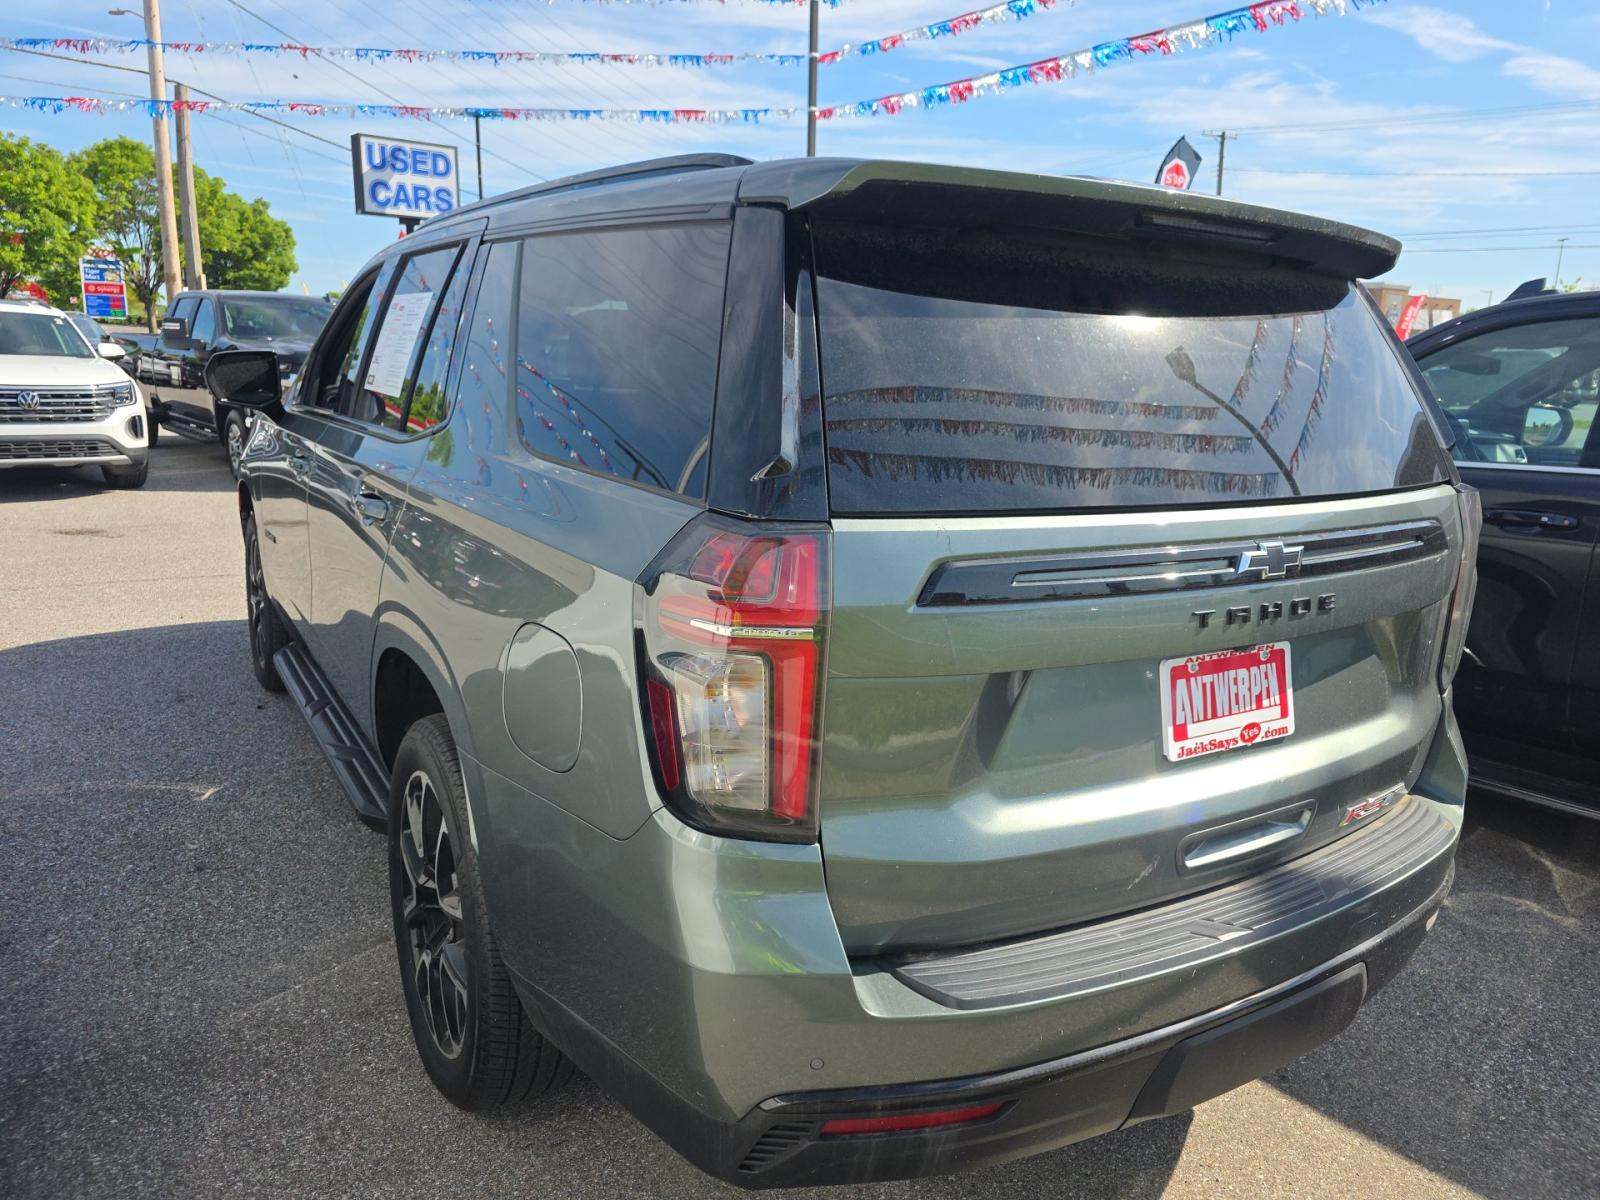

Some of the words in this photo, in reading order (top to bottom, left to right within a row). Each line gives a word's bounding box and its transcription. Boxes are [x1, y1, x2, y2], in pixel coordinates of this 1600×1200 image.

[366, 143, 451, 177] USED
[370, 180, 453, 212] CARS
[1192, 593, 1336, 628] TAHOE
[1176, 662, 1281, 726] ANTWERPEN
